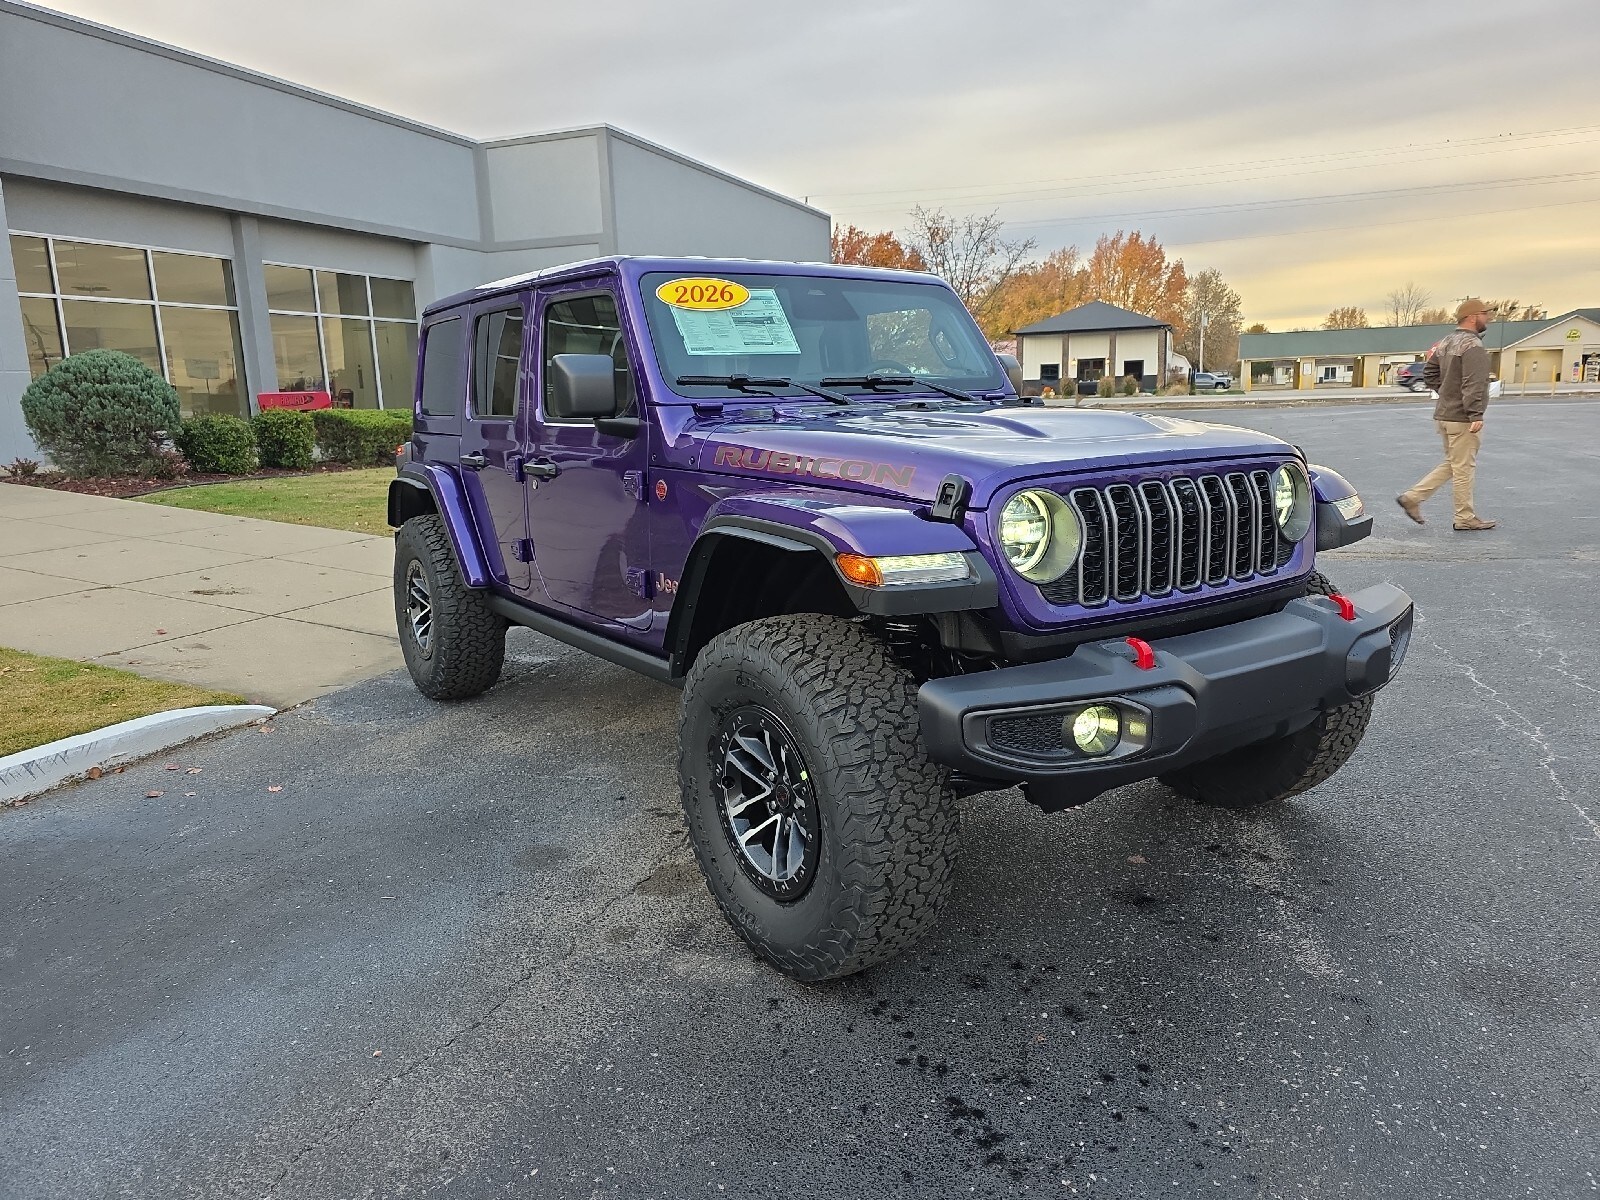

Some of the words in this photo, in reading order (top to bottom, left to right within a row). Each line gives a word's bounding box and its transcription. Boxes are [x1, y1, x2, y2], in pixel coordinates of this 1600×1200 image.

[674, 284, 734, 304] 2026
[713, 445, 917, 489] RUBICON
[655, 572, 679, 595] Jee
